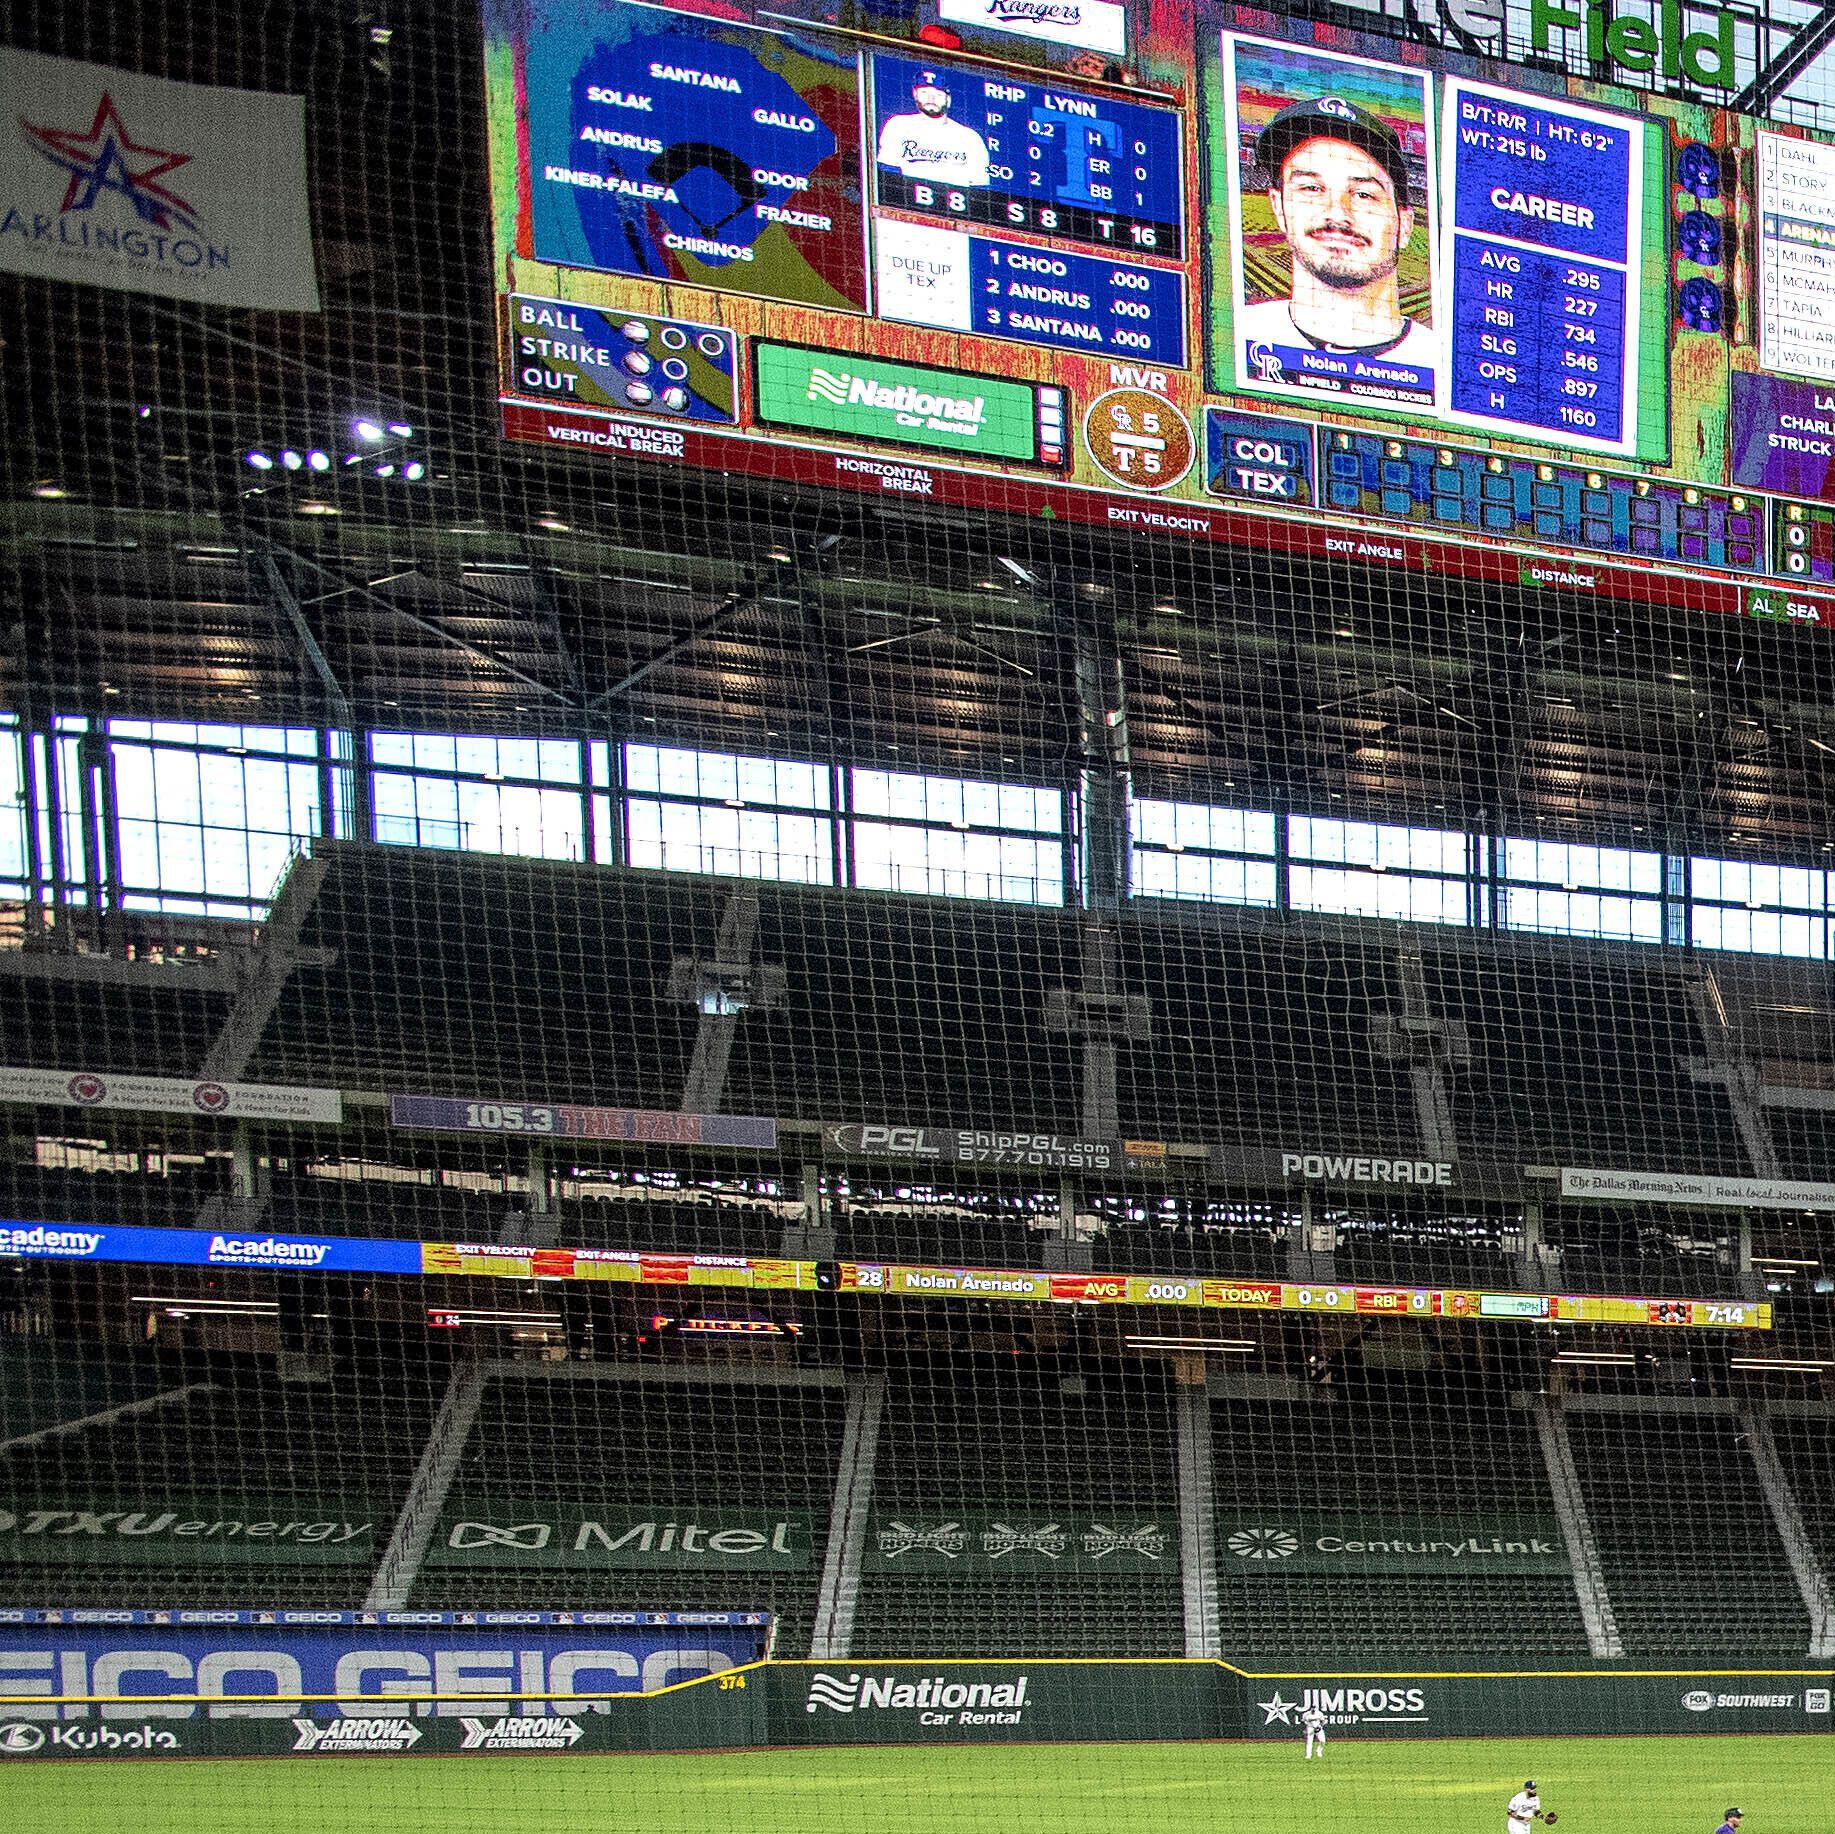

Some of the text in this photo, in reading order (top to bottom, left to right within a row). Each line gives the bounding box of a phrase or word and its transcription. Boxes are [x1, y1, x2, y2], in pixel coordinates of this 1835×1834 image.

[650, 63, 742, 93] SANTANA
[587, 86, 653, 112] SOLAK
[985, 82, 1097, 119] RHP LYNN
[753, 108, 815, 132] GALLO
[580, 126, 663, 154] ANDRUS
[544, 166, 679, 204] KINER-FALEFA
[753, 169, 810, 191] ODOR
[755, 204, 832, 231] FRAZIER
[1490, 187, 1595, 230] CAREER
[1, 206, 231, 269] ARLINGTON
[664, 233, 754, 262] CHIRINOS
[1130, 224, 1156, 246] 16
[906, 273, 936, 289] TEX
[1007, 253, 1150, 291] CHOO .000
[1480, 250, 1601, 290] AVG .295
[1008, 281, 1150, 320] ANDRUS .000
[1487, 279, 1598, 317] HR 227
[520, 305, 584, 332] BALL
[1008, 312, 1151, 349] SANTANA .000
[1485, 306, 1597, 345] RBI 734
[520, 337, 610, 367] STRIKE
[1480, 334, 1599, 372] SLG .546
[522, 368, 578, 392] OUT
[1110, 365, 1168, 392] MVR
[1302, 354, 1419, 385] Nolan Arenado
[1478, 362, 1598, 399] OPS .897
[848, 377, 986, 423] National
[1560, 406, 1597, 428] 1160
[547, 426, 684, 457] VERTICAL BREAK
[610, 423, 684, 444] INDUCED
[1768, 433, 1832, 456] STRUCK
[1235, 438, 1289, 466] COL
[836, 457, 933, 484] HORIZONTAL
[1236, 468, 1288, 496] TEX
[881, 478, 933, 495] BREAK
[1107, 507, 1210, 533] EXIT VELOCITY
[1325, 539, 1403, 560] EXIT ANGLE
[1531, 568, 1595, 588] DISTANCE
[1752, 597, 1774, 615] AL
[1786, 602, 1820, 621] SEA
[467, 1104, 702, 1140] 105.3 THE FAN
[861, 1127, 940, 1153] PGL
[958, 1132, 1110, 1154] ShipPGL.com
[959, 1149, 1110, 1169] 877.701.1919
[1281, 1154, 1451, 1186] POWERADE
[1569, 1174, 1703, 1196] The Dallas Morning News
[209, 1235, 328, 1264] Academy
[456, 1244, 536, 1257] EXIT VELOCITY
[576, 1250, 640, 1261] EXIT ANGLE
[694, 1255, 747, 1266] DISTANCE
[858, 1272, 1745, 1323] 28 Nolan Arenado AVG .000 TODAY RBI 7:14
[574, 1521, 791, 1553] Mitel
[1316, 1536, 1552, 1556] CenturyLink
[72, 1611, 133, 1622] GEICO
[180, 1611, 239, 1622] GEICO
[285, 1612, 342, 1623] GEICO
[387, 1612, 442, 1623] GEICO
[486, 1614, 540, 1625] GEICO
[583, 1614, 636, 1625] GEICO
[677, 1614, 728, 1625] GEICO
[336, 1650, 735, 1719] GEICO
[719, 1676, 745, 1690] 374
[860, 1677, 1029, 1709] National
[1689, 1693, 1794, 1708] FOX SOUTHWEST
[325, 1719, 404, 1740] ARROW
[490, 1718, 565, 1738] ARROW
[920, 1710, 1022, 1725] Car Rental
[52, 1725, 180, 1750] Kubota
[320, 1739, 403, 1750] EXTERMINATORS
[486, 1738, 565, 1749] EXTERMINATORS
